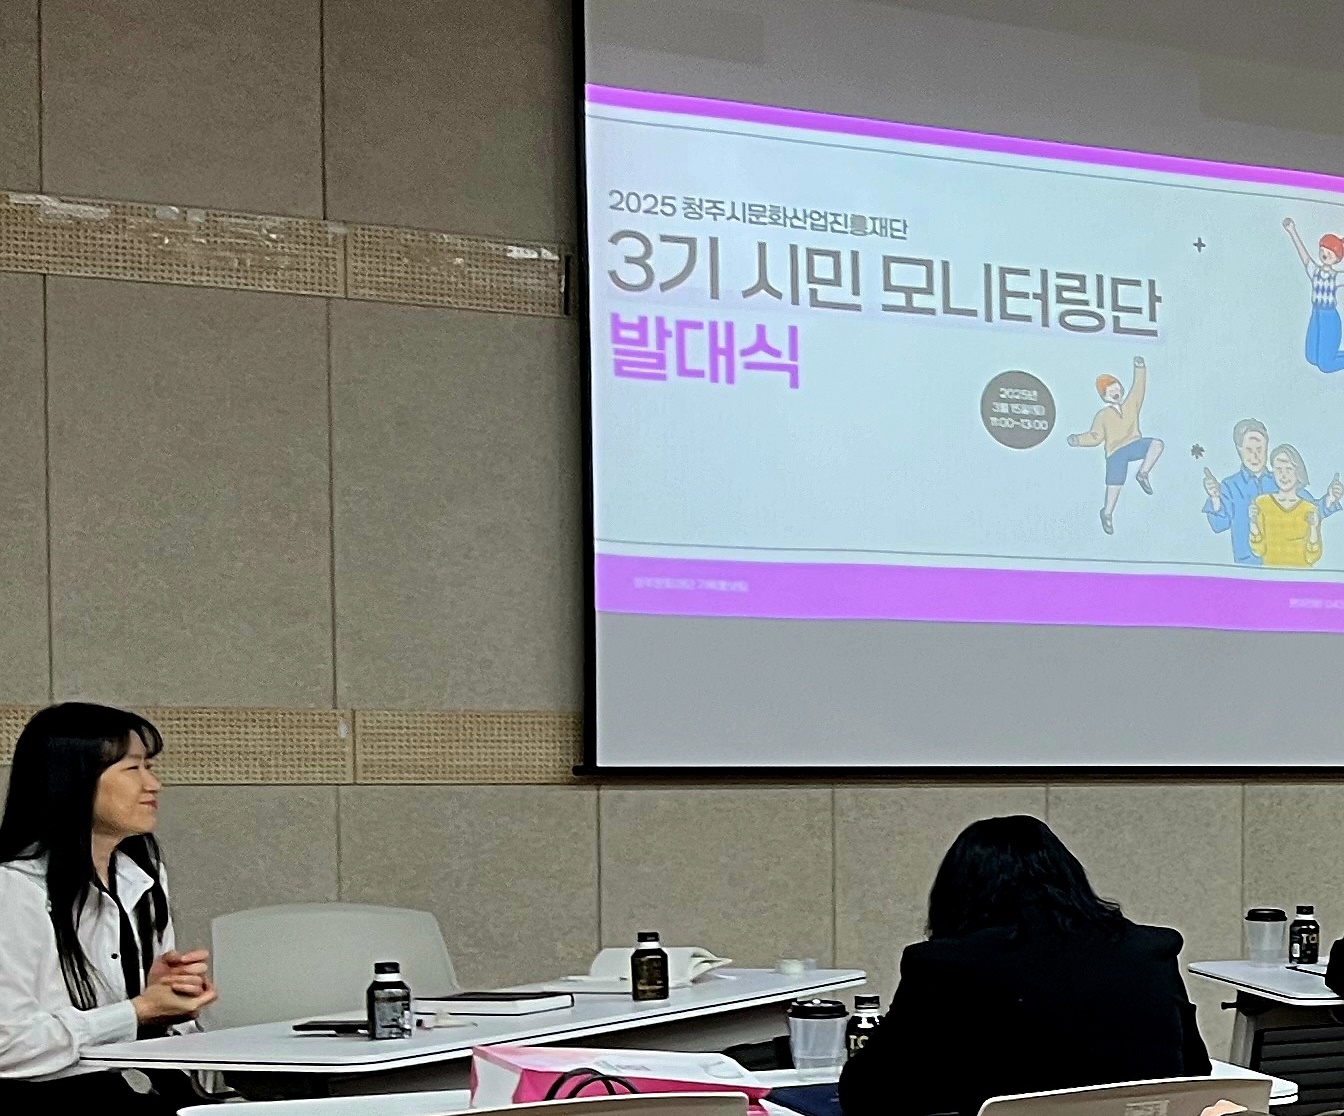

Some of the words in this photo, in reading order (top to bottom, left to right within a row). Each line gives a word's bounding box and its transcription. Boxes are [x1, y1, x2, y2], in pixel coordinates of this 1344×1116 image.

[608, 190, 677, 217] 2025
[607, 229, 720, 300] 3기
[741, 242, 863, 312] 시민
[881, 254, 1163, 338] 모니터링단
[610, 312, 800, 389] 발대식
